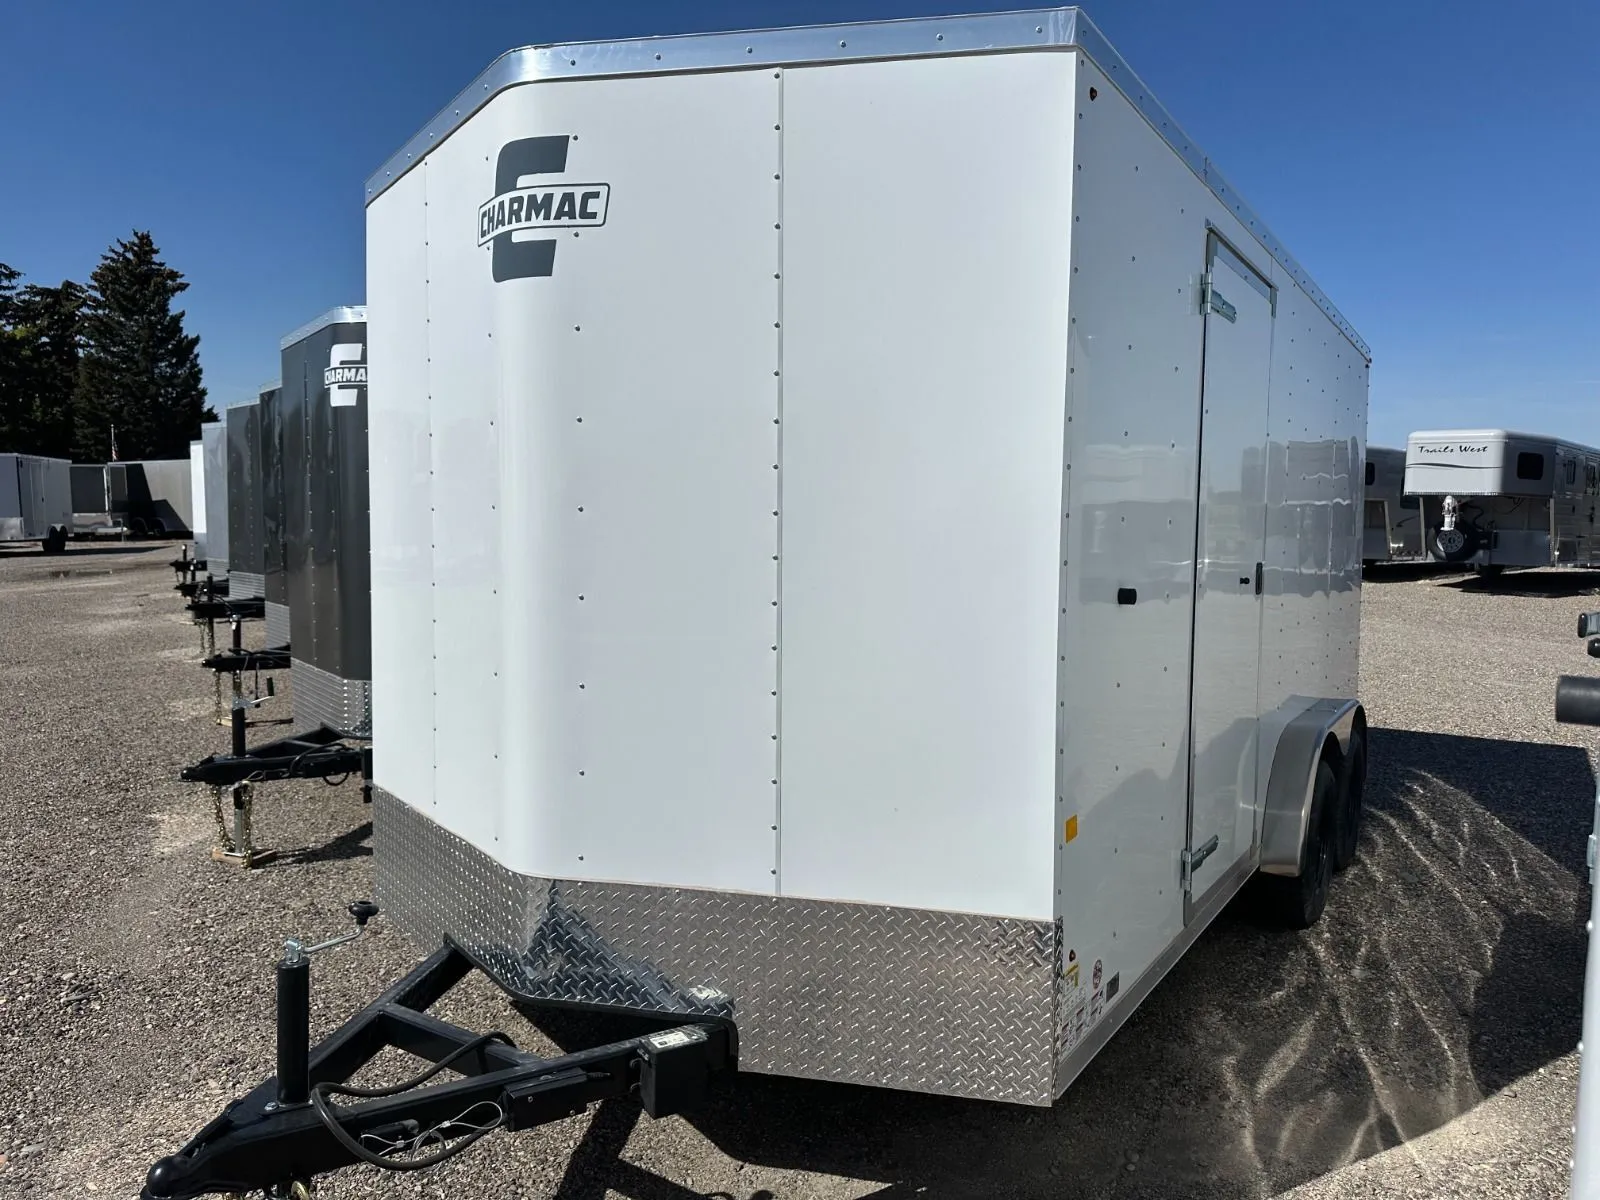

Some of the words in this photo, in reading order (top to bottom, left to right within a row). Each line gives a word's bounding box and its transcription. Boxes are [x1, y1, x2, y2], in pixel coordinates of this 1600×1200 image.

[480, 191, 600, 239] CHARMAC
[1418, 445, 1454, 454] Trails
[1459, 445, 1488, 453] West
